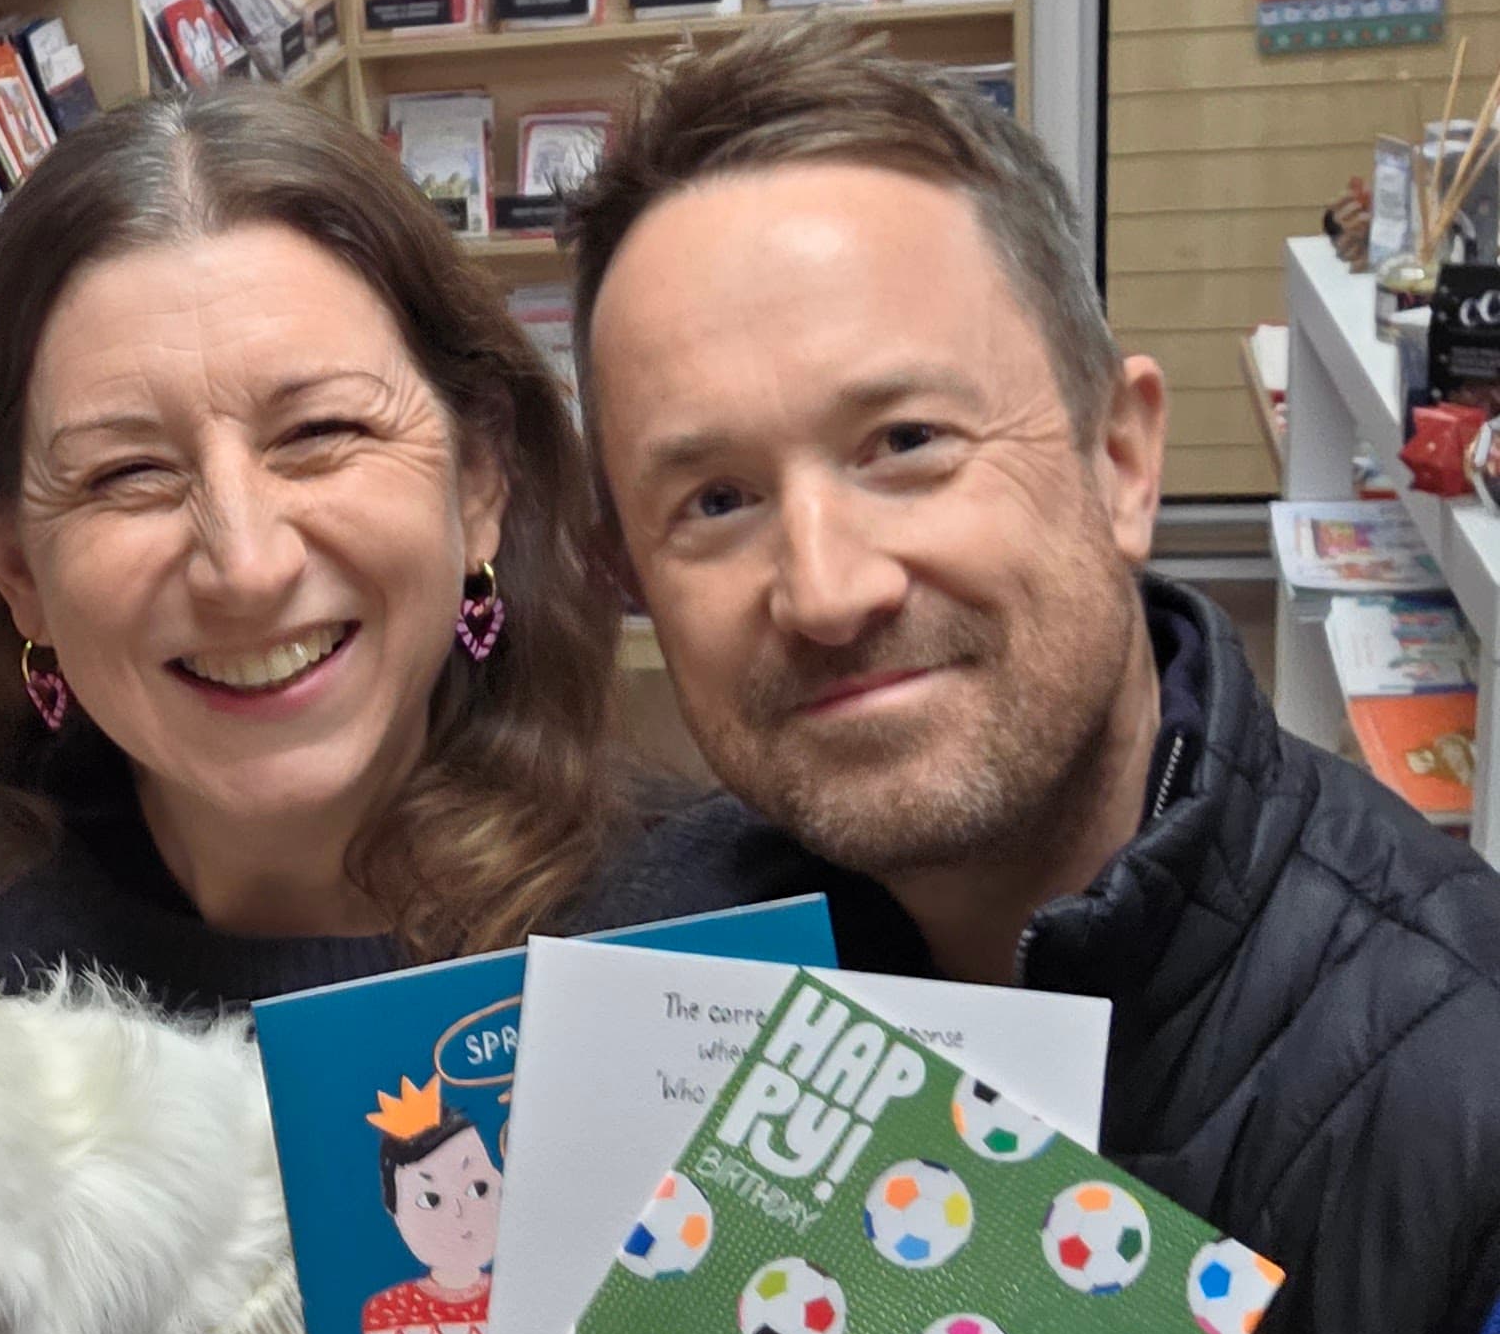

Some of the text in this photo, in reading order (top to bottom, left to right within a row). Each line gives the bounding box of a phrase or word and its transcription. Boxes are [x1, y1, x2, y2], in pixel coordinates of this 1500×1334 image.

[466, 1025, 519, 1066] SPR
[663, 991, 699, 1021] The
[708, 1004, 766, 1028] corre
[763, 984, 927, 1123] HAP
[716, 1062, 874, 1201] PY!
[695, 1145, 821, 1235] BIRTHDAY
